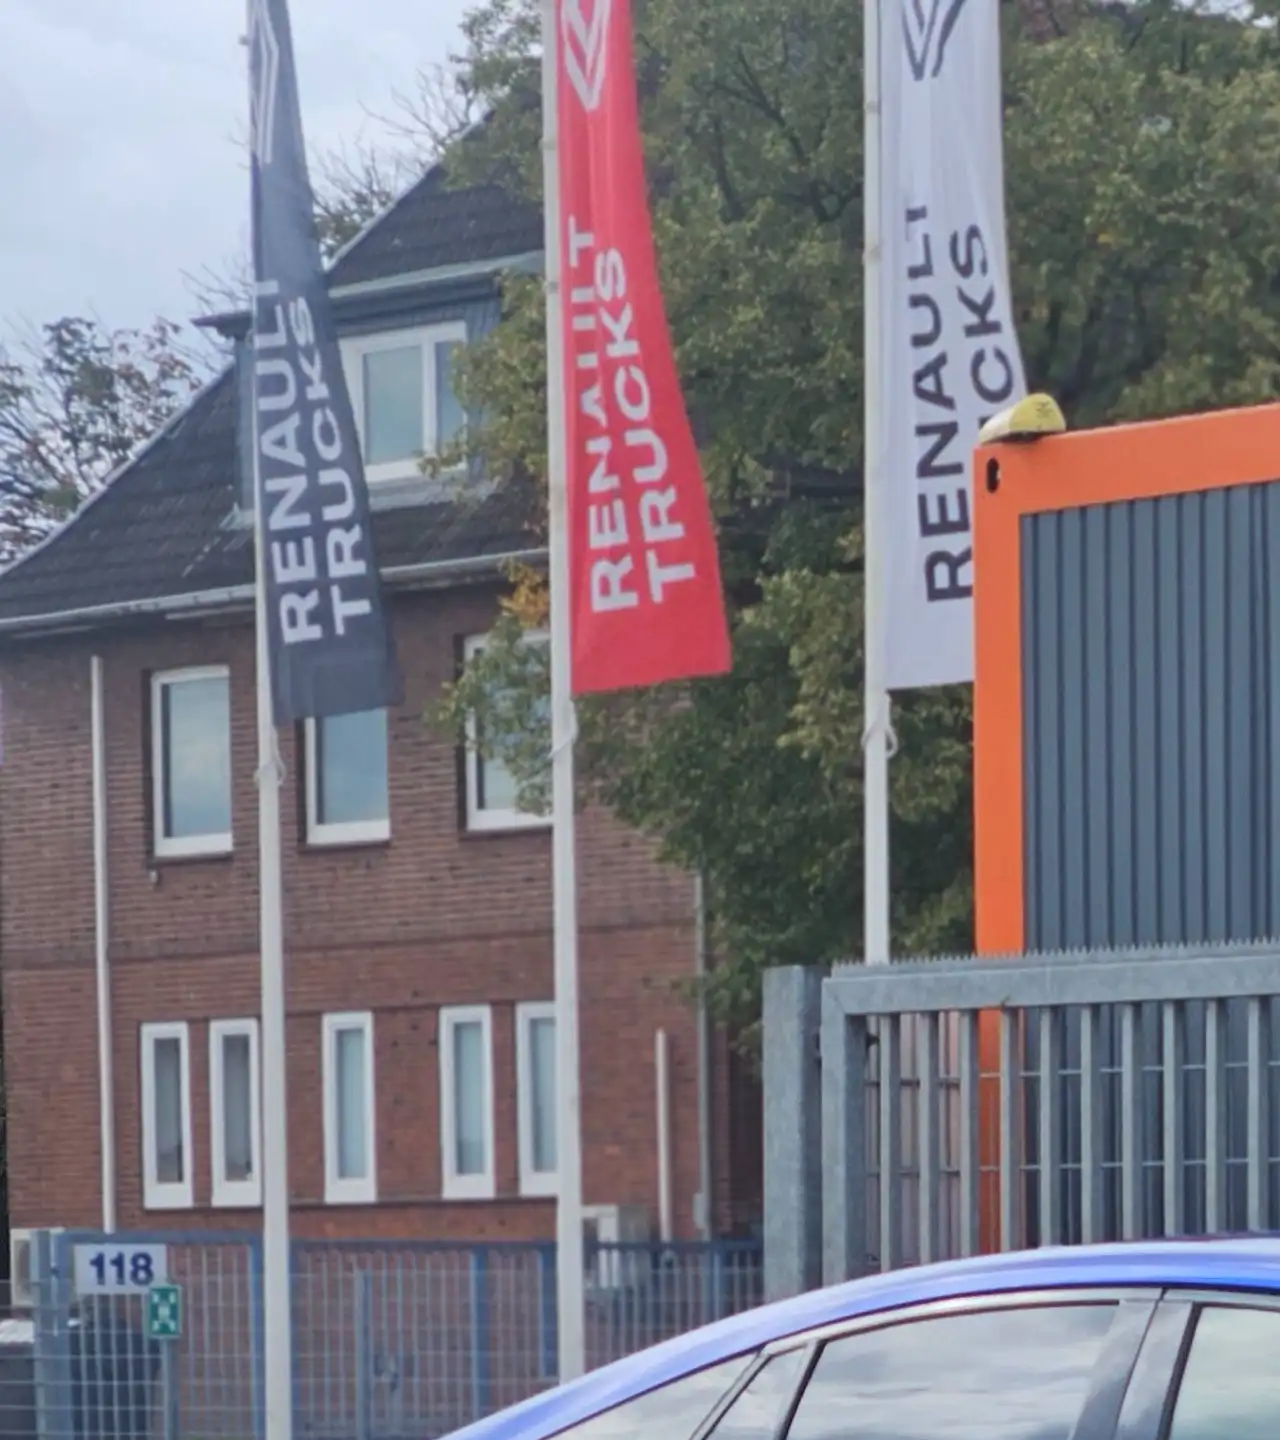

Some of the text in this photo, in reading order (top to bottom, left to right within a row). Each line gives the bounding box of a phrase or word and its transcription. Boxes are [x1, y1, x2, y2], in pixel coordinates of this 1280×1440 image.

[594, 248, 696, 603] TRUCKS
[949, 223, 1013, 431] CKS
[289, 297, 372, 636] TRUCKS
[89, 1251, 154, 1286] 118
